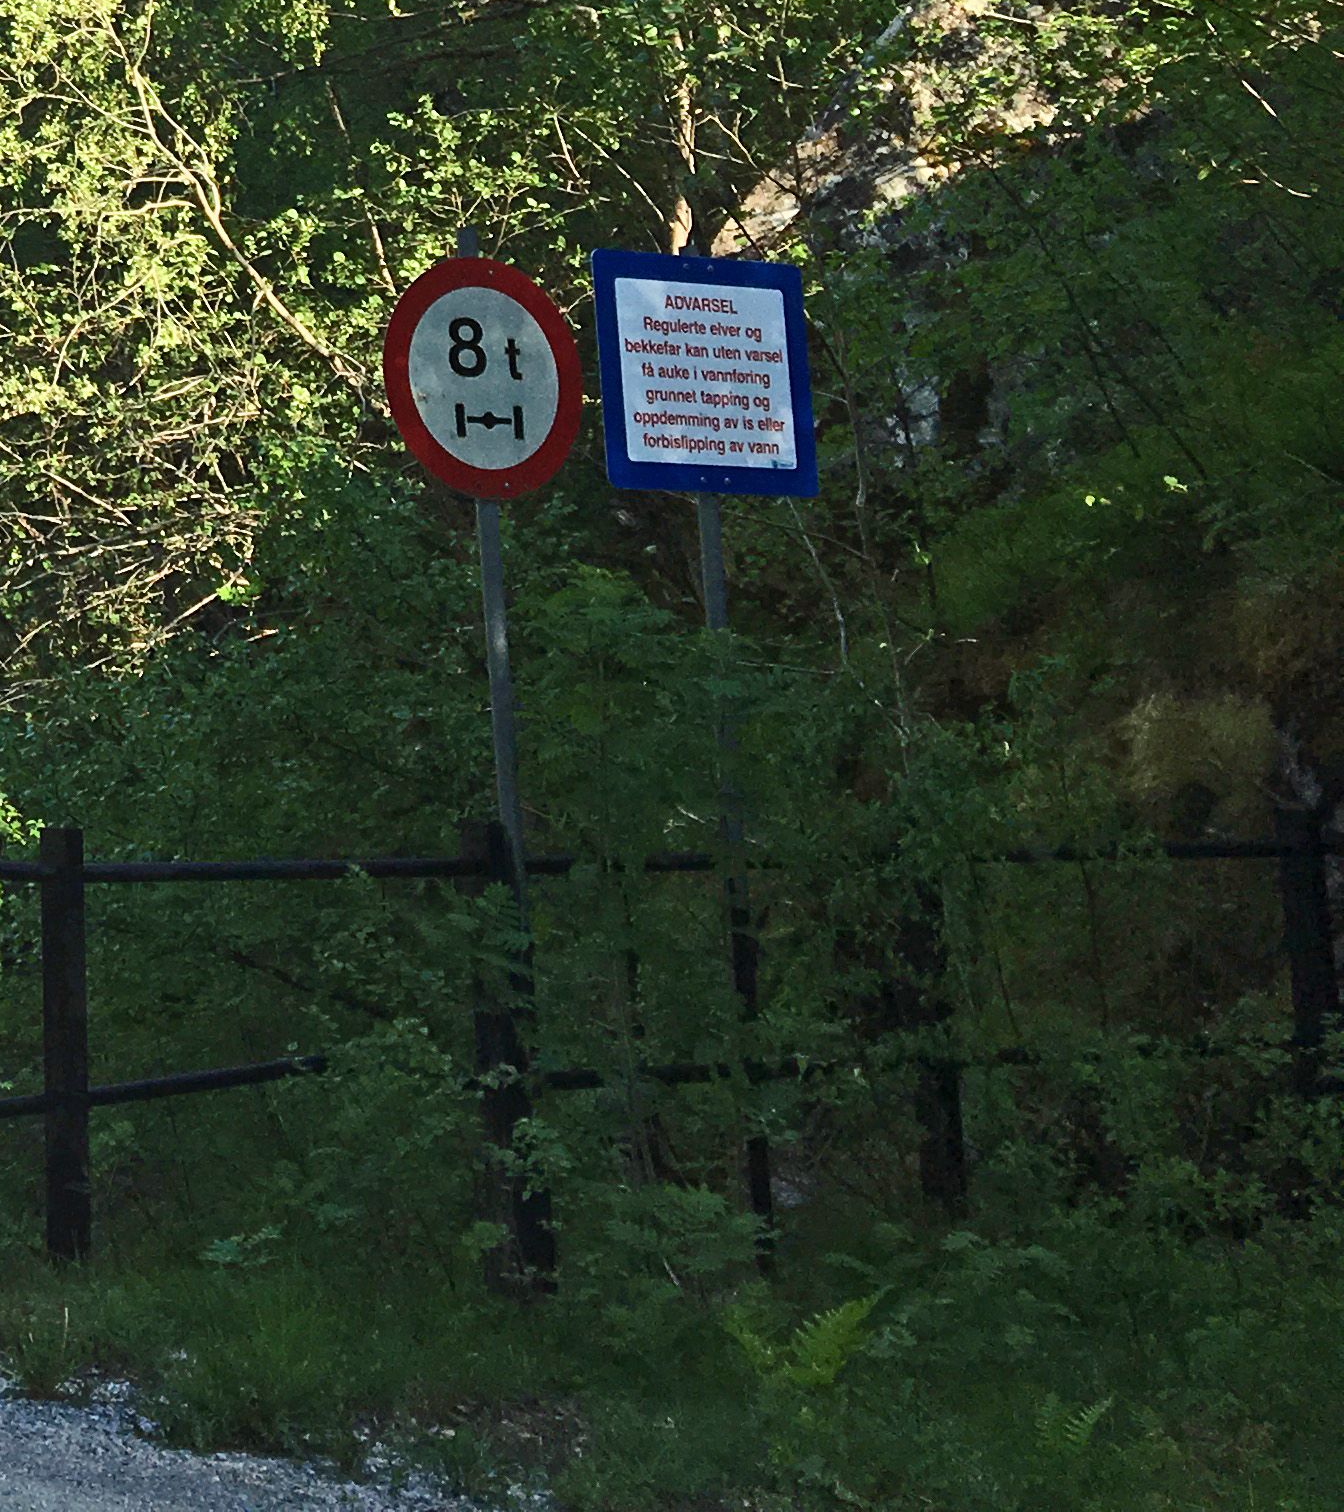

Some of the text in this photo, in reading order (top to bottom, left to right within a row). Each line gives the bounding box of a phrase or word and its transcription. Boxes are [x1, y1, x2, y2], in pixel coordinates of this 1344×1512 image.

[665, 295, 738, 314] ADVARSEL
[644, 317, 762, 342] Regulerte elver og
[448, 317, 523, 380] 8 t
[625, 339, 782, 363] bekkefar kan uten varsel
[642, 363, 770, 388] få auke i vannføring
[646, 389, 769, 411] grunnet tapping og
[634, 412, 785, 432] oppdemming av is eller
[730, 442, 744, 452] av
[748, 443, 779, 454] vann
